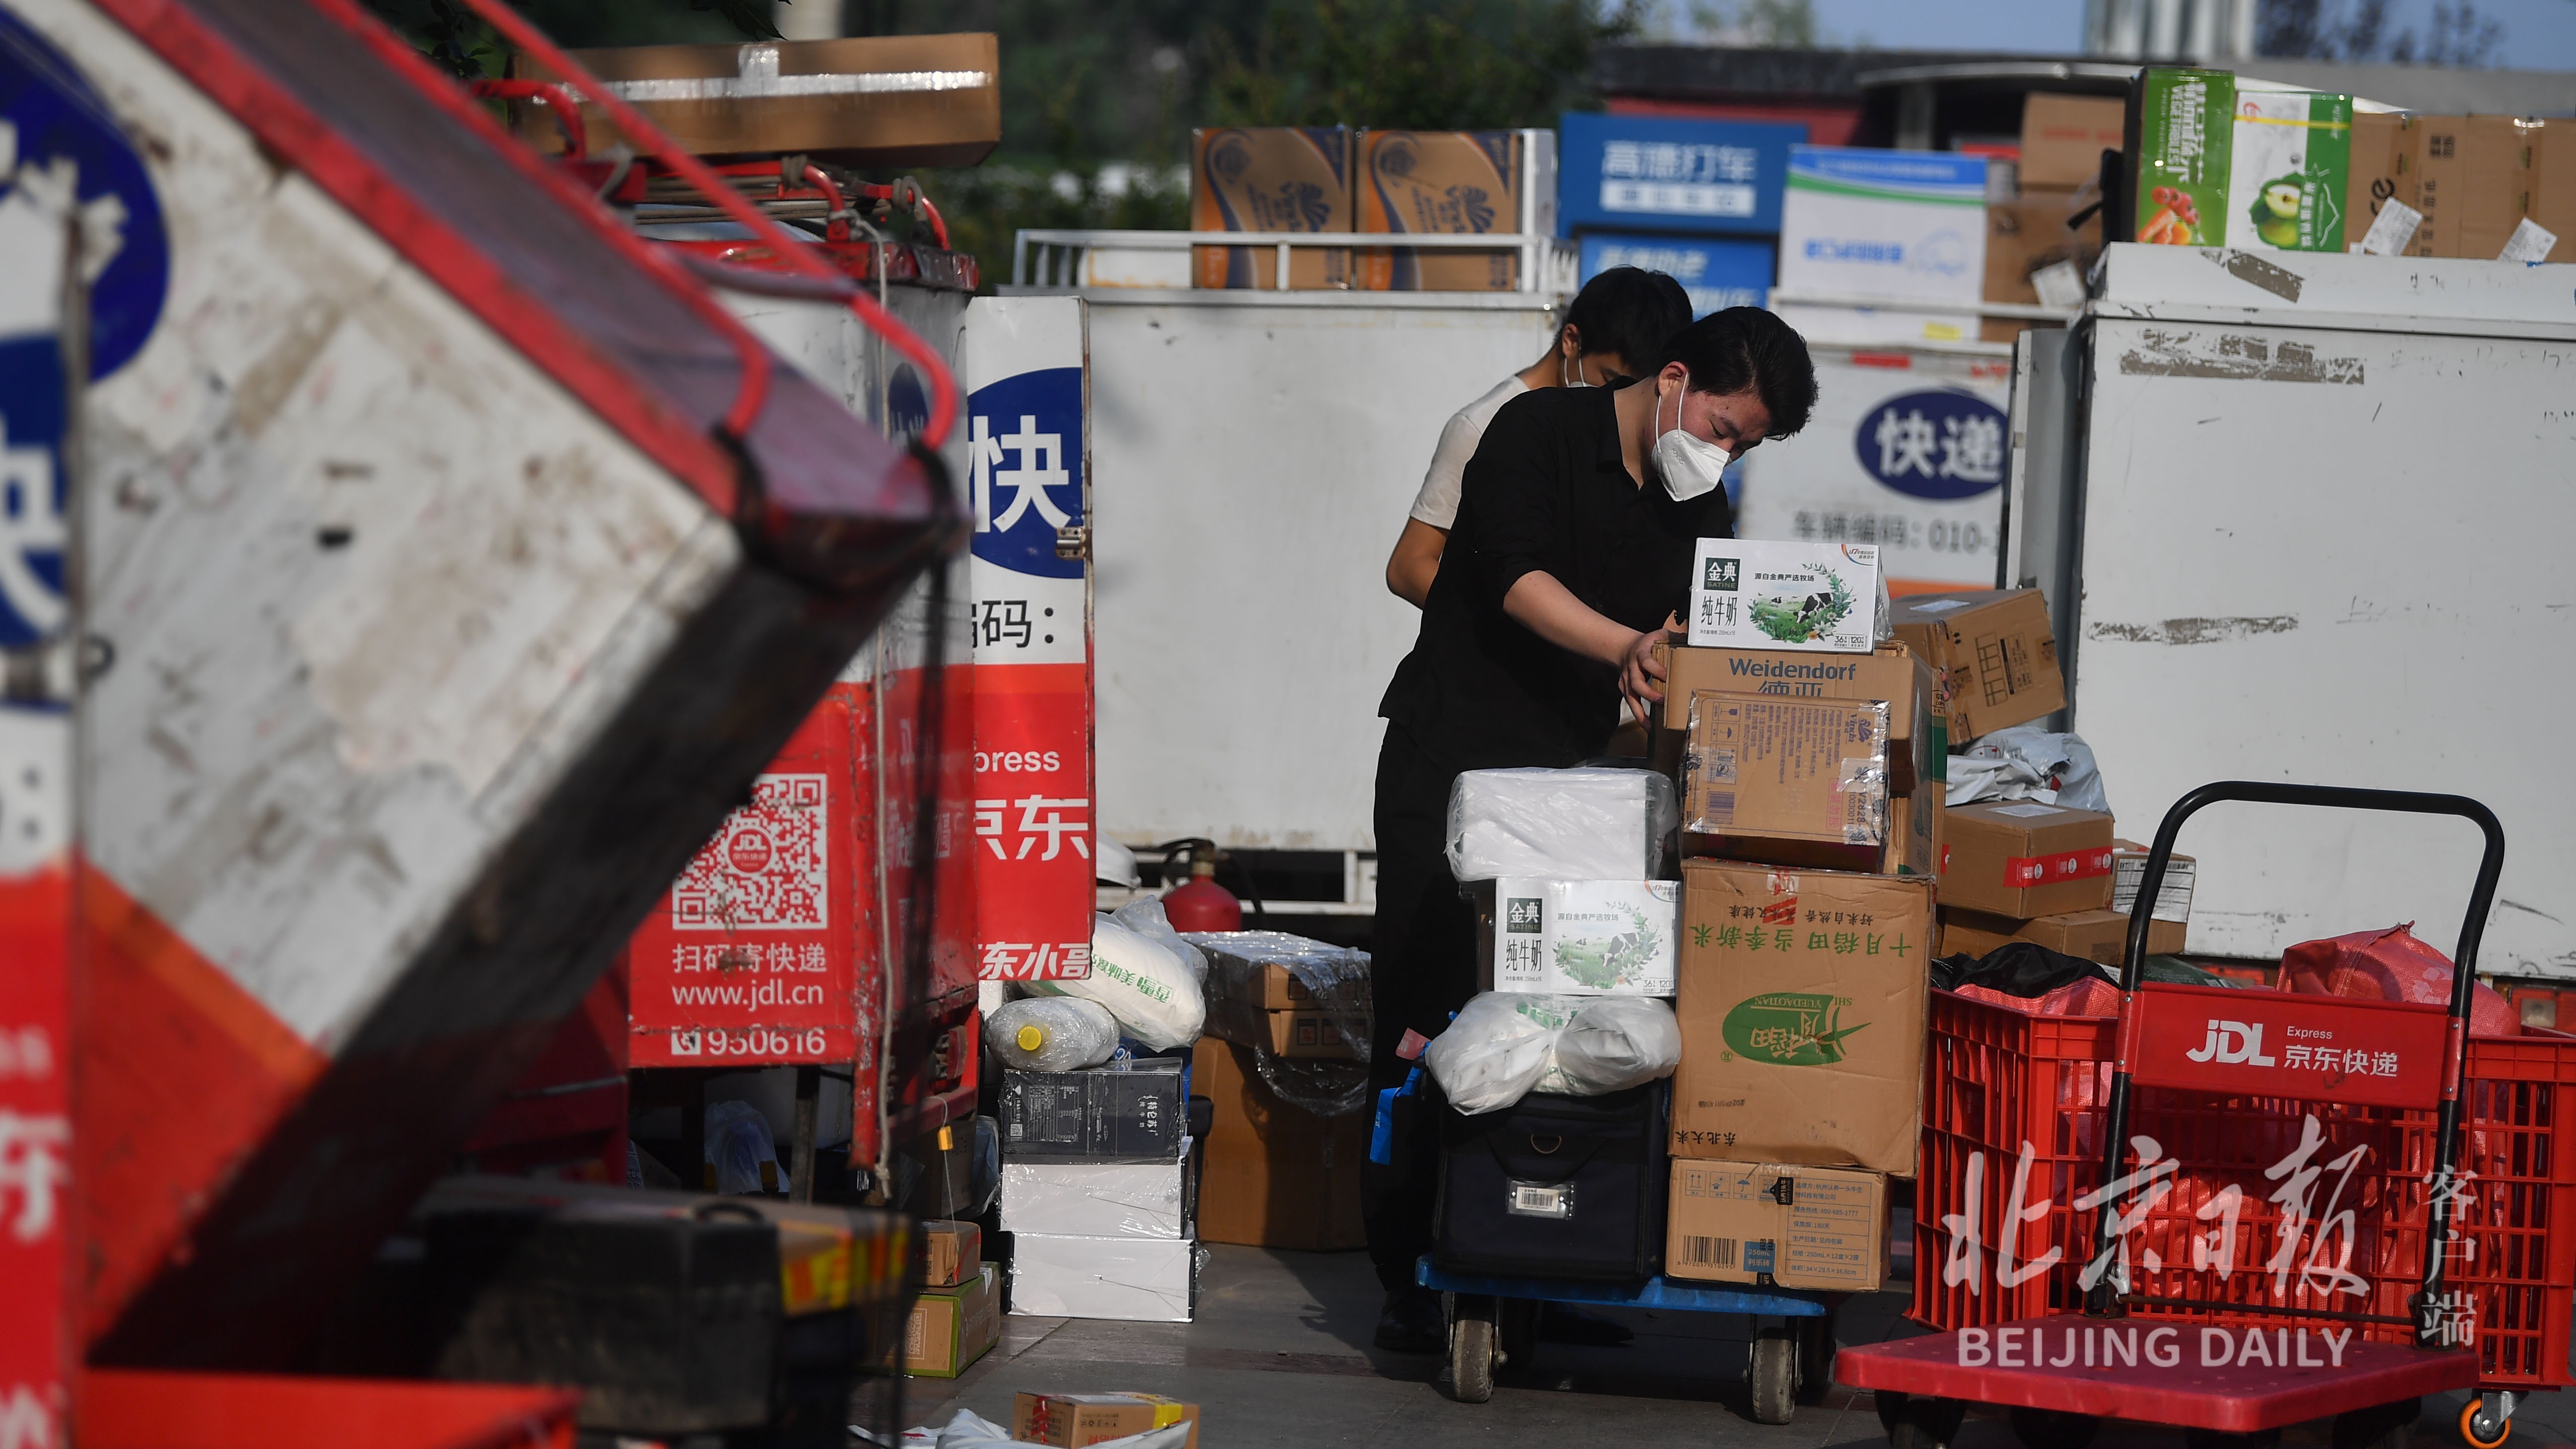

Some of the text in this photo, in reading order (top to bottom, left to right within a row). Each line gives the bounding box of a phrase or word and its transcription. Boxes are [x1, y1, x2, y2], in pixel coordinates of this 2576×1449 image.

[1875, 408, 2004, 481] 快递
[969, 415, 1071, 533] 快
[1793, 509, 1999, 554] 车辆编码：010-
[1707, 561, 1737, 582] 金典
[1754, 572, 1815, 582] 源自金典严选牧场
[1700, 595, 1738, 626] 纯牛奶
[1728, 658, 1856, 680] Weidendorf
[1848, 713, 1857, 743] Vinda
[733, 834, 767, 851] JDL
[1509, 901, 1539, 924] 金典
[1557, 912, 1619, 921] 源自金典严选牧场
[1805, 908, 1873, 927] 好米自然香
[1689, 922, 1913, 958] 十月稻田 当季新米
[672, 943, 827, 973] 扫码寄快递
[977, 941, 1089, 981] 东小哥
[1506, 938, 1542, 972] 纯牛奶
[672, 980, 823, 1012] www.jdl.cn
[1754, 996, 1822, 1009] YUEDAOTIAN
[708, 1027, 826, 1056] 950616
[2186, 1019, 2275, 1067] JDL
[2287, 1025, 2333, 1040] Express
[2283, 1044, 2398, 1078] 京东快递
[1146, 1101, 1158, 1129] 特仑苏
[1675, 1130, 1736, 1146] 东北大米
